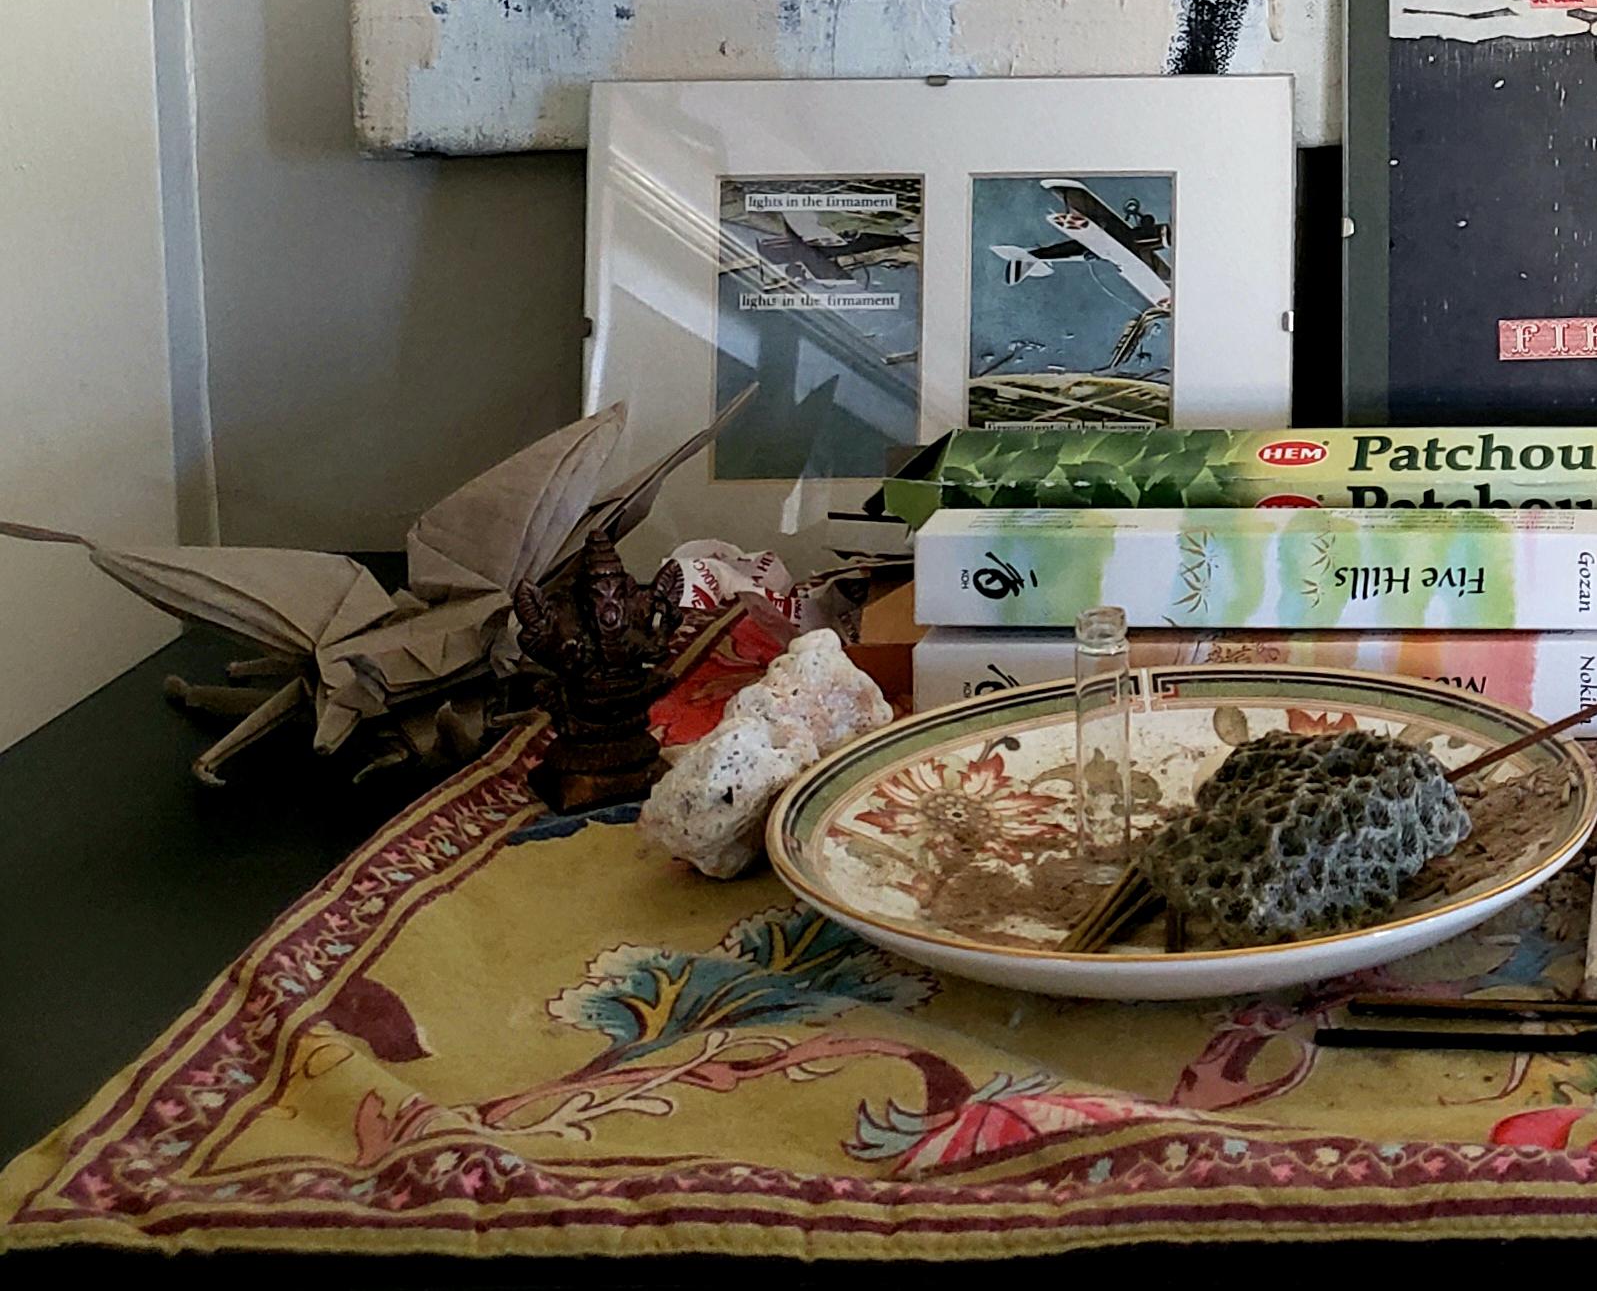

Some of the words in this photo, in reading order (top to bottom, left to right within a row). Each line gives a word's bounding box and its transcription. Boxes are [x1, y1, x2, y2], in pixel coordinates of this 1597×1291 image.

[748, 196, 783, 210] lights
[787, 196, 798, 207] in
[802, 196, 822, 207] the
[826, 195, 894, 207] firmament
[742, 295, 776, 308] lights
[783, 296, 794, 306] in
[828, 295, 895, 306] firmament
[1262, 447, 1323, 460] HEM
[960, 569, 970, 590] KOH
[1334, 566, 1411, 601] Hills
[1421, 566, 1486, 598] Five
[1578, 551, 1596, 613] Gozan
